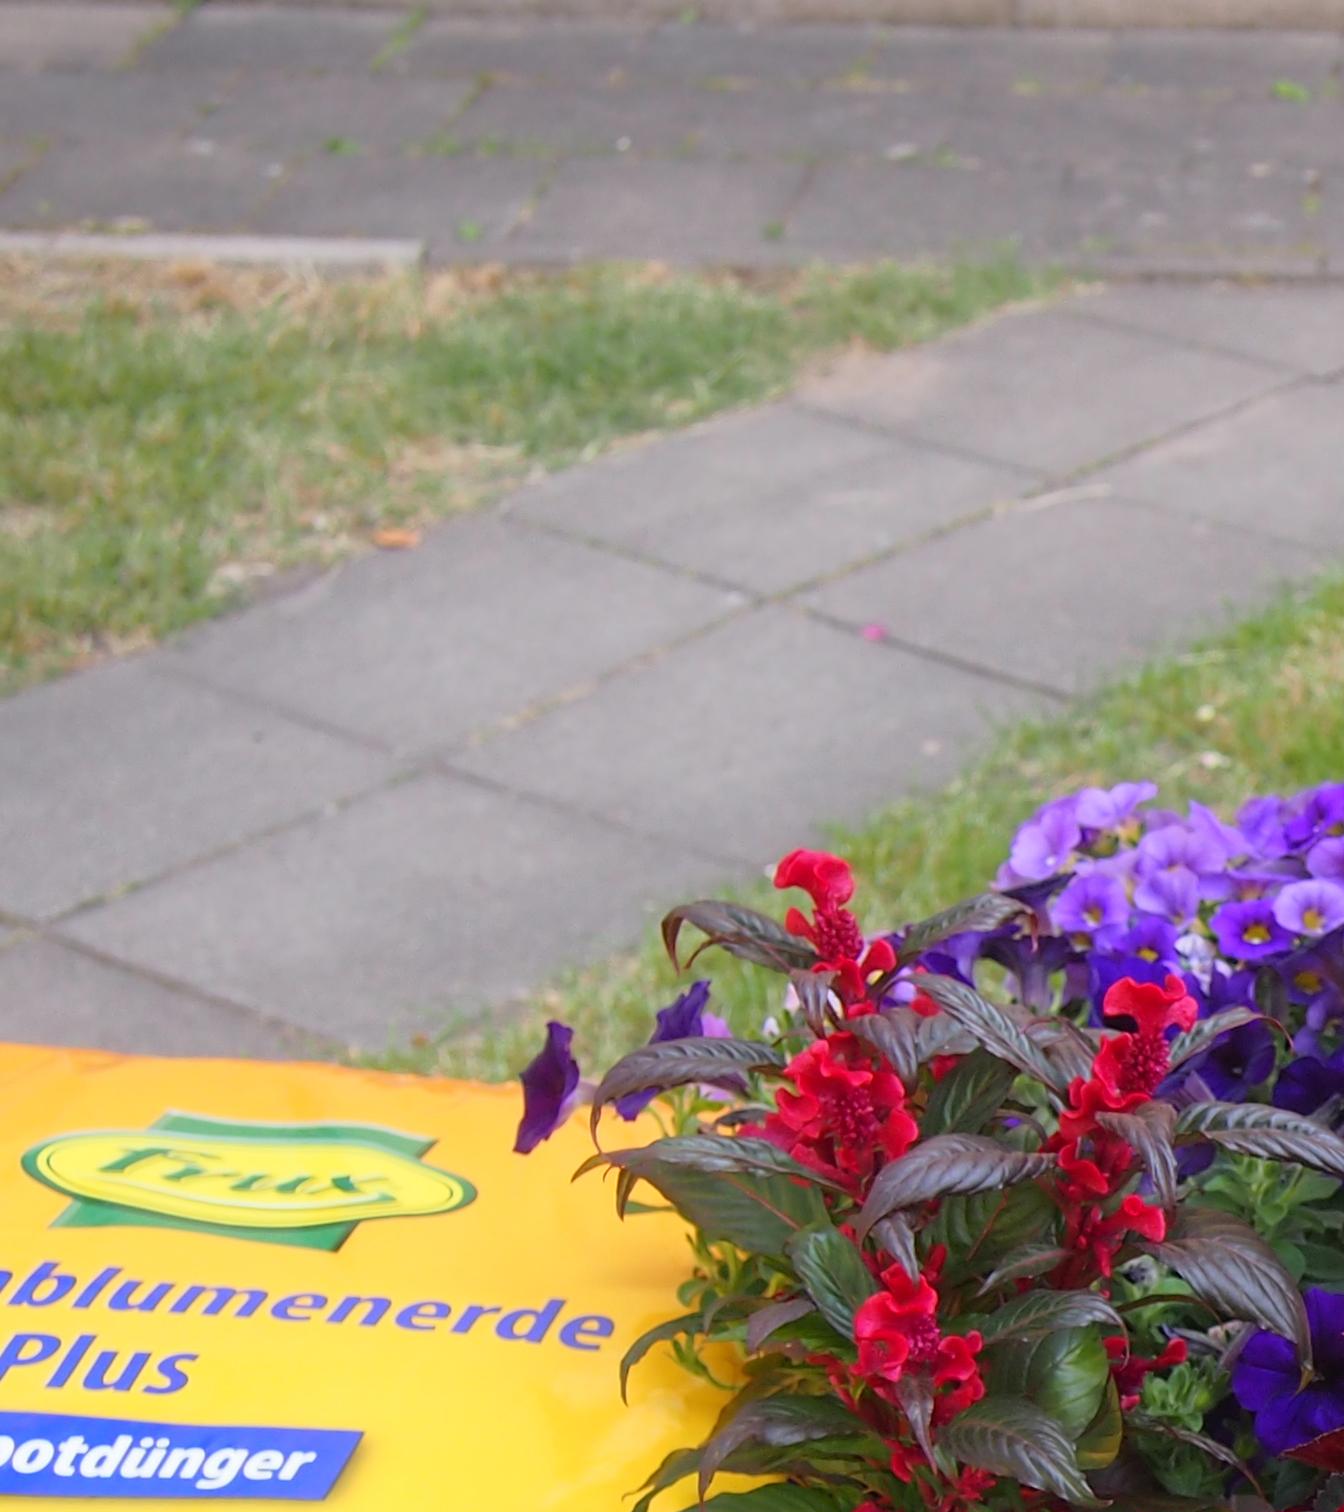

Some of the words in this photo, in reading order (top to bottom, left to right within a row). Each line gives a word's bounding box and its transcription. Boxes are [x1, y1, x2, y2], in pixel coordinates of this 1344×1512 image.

[0, 1261, 616, 1351] blumenerde
[0, 1332, 200, 1395] Plus
[0, 1434, 317, 1490] otdünger
